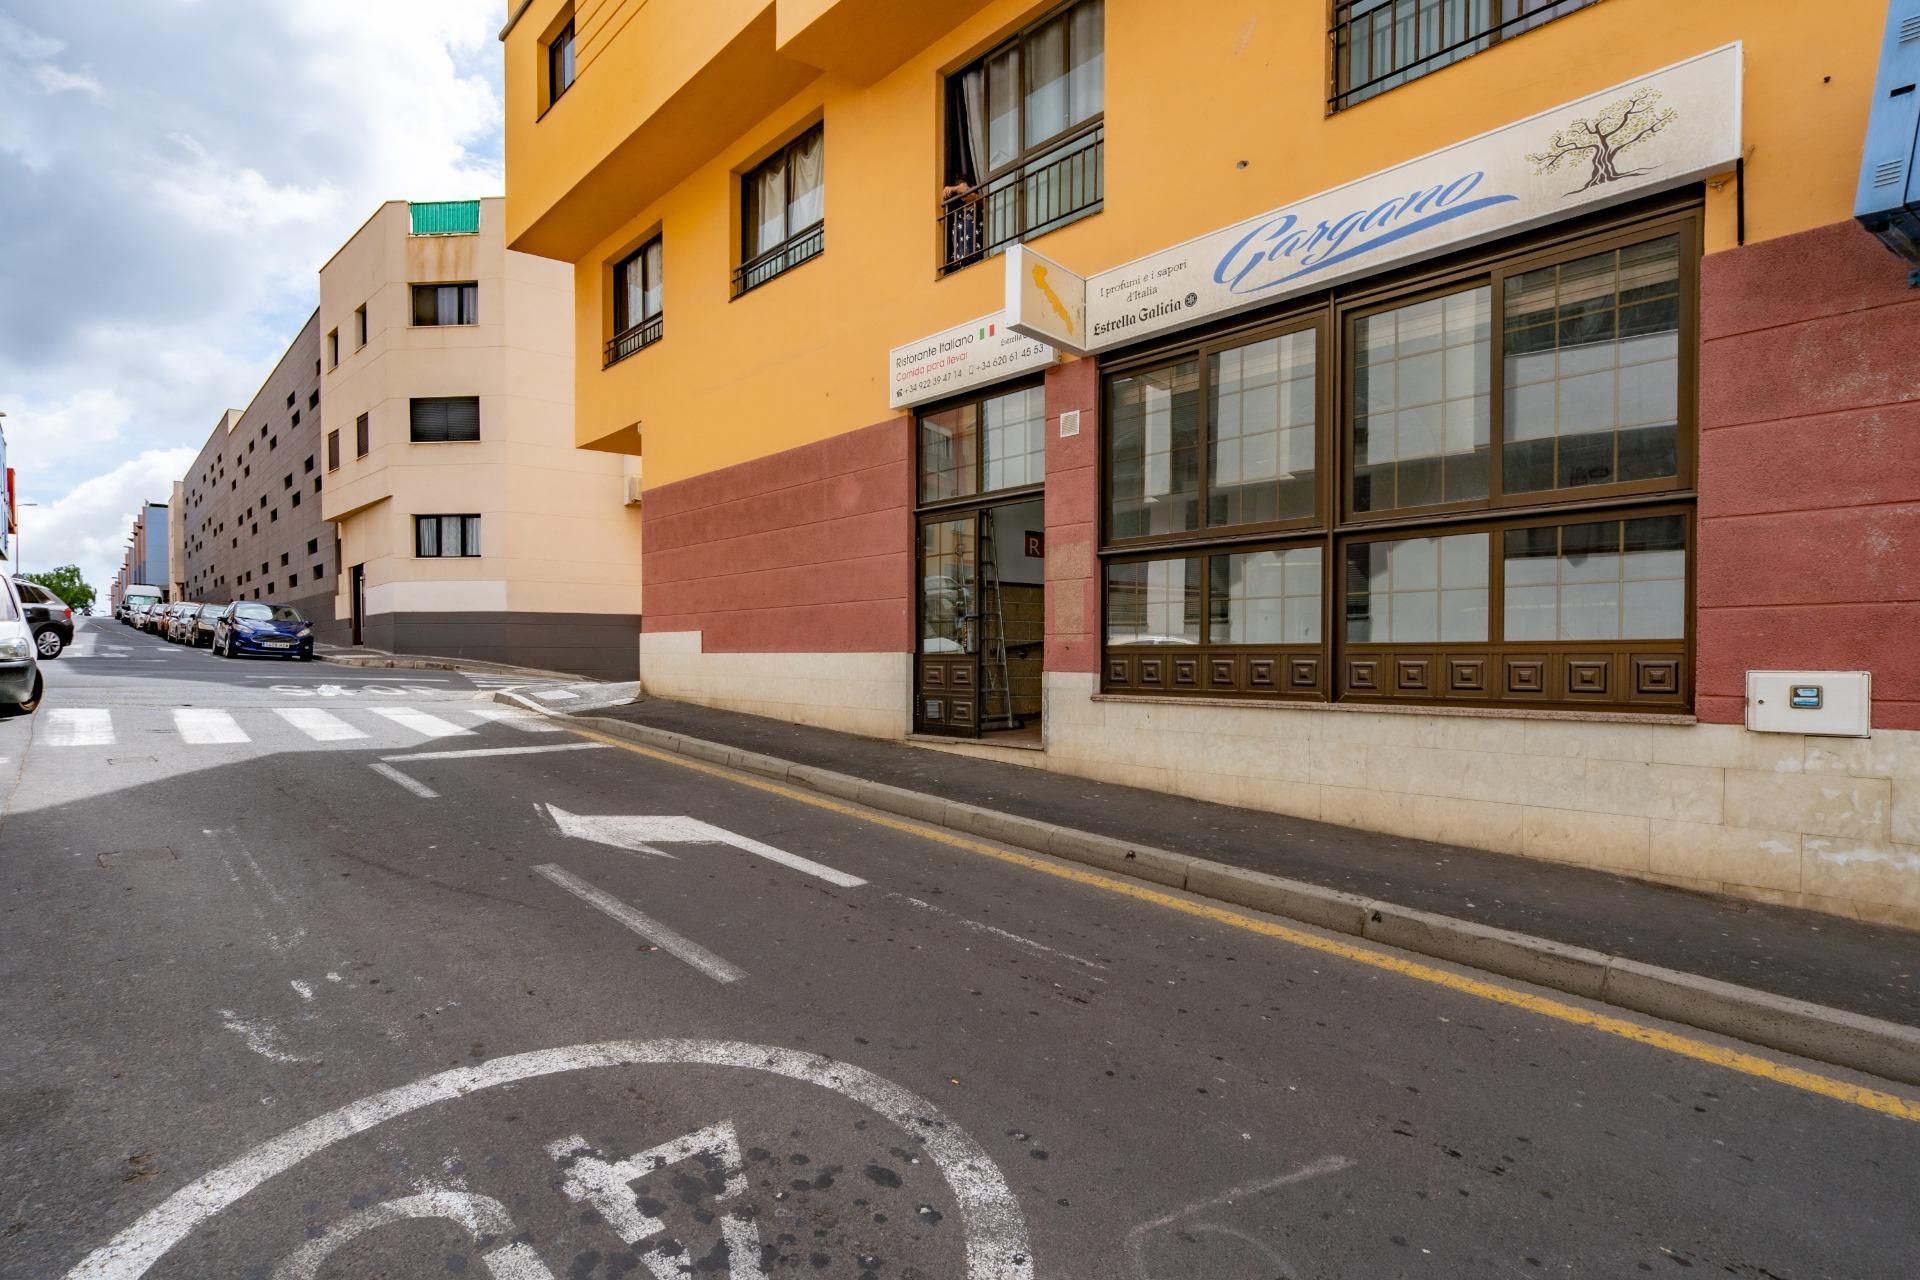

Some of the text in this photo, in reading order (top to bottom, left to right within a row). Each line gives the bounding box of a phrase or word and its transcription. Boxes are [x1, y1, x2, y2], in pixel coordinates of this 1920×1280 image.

[1213, 170, 1485, 293] Gargano
[1100, 287, 1104, 297] I
[1106, 276, 1141, 298] profumi
[1143, 273, 1149, 283] e
[1157, 259, 1188, 278] sapori
[1126, 285, 1158, 303] d'Italia
[1093, 298, 1181, 336] Estrella Galicia
[896, 333, 974, 368] Ristorante Italiano
[896, 351, 968, 382] Comida para llevar
[976, 343, 1043, 372] +34 620 61 45 53
[905, 368, 962, 394] +34 922 39 47 14
